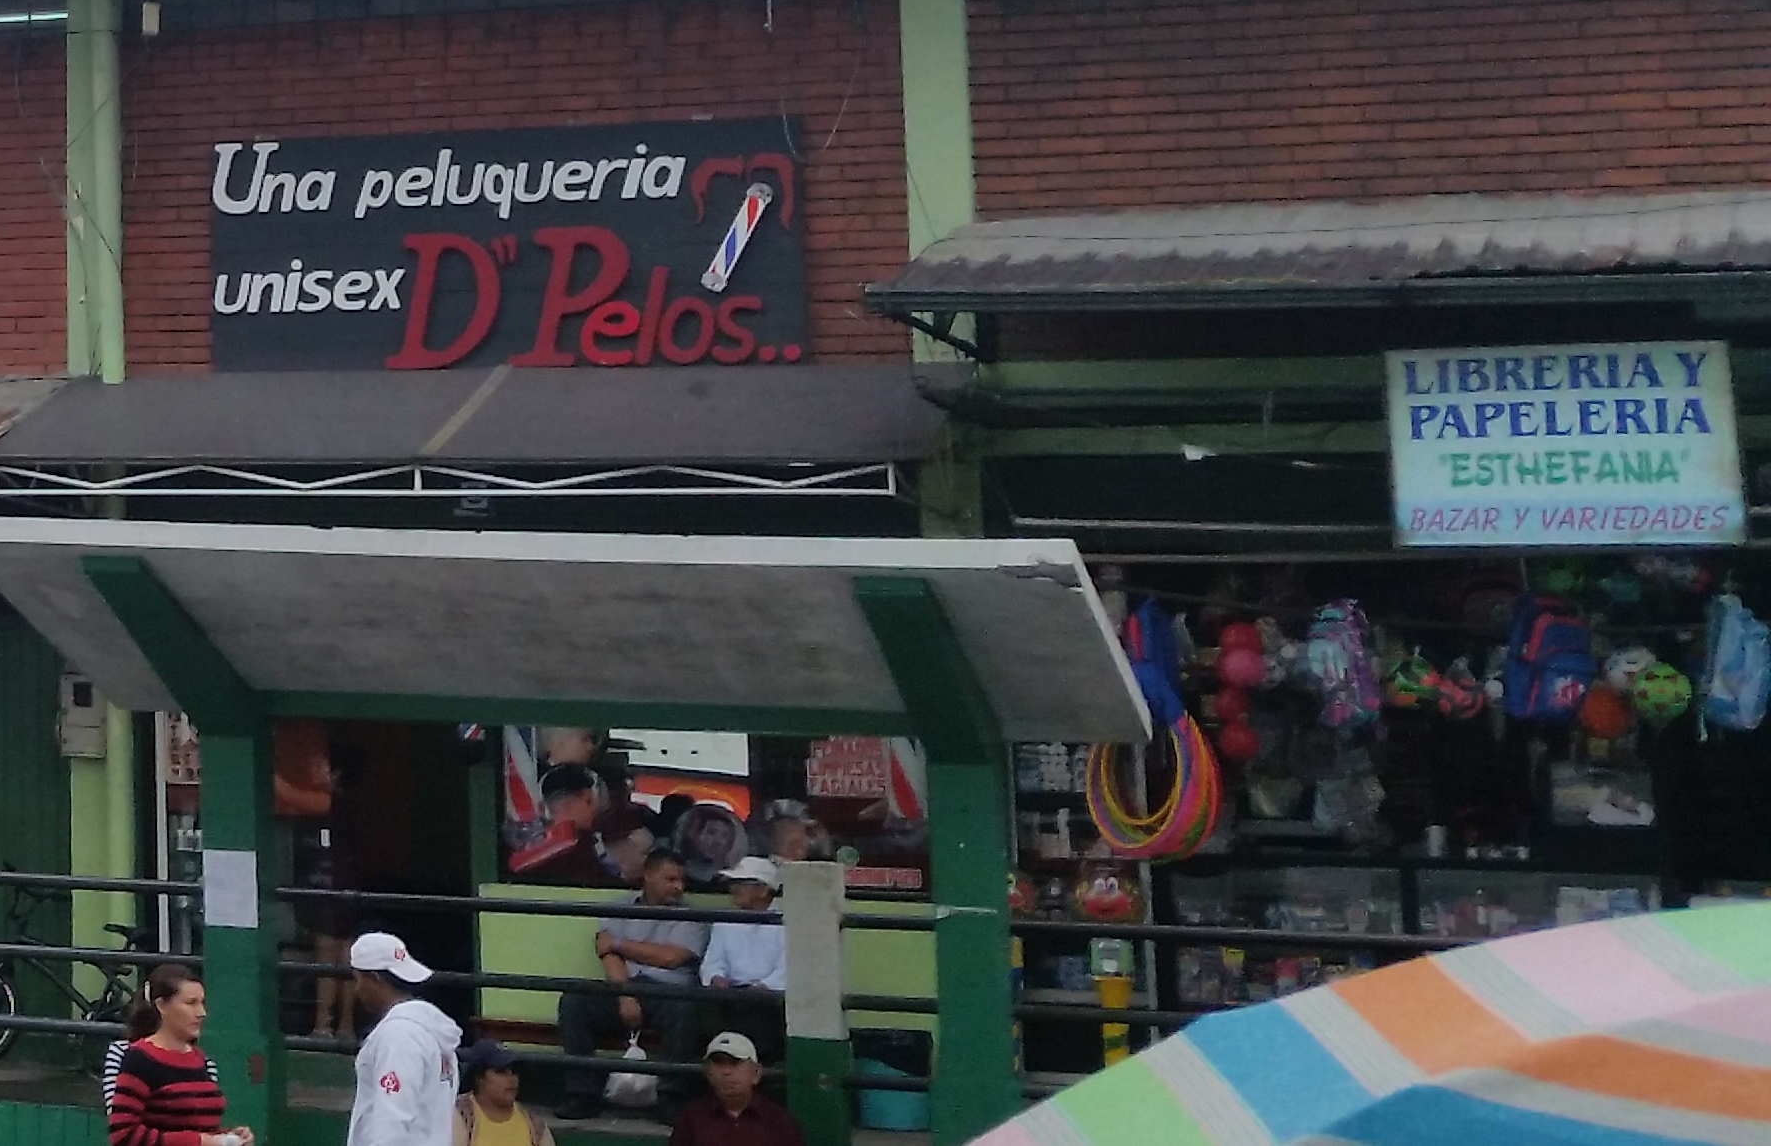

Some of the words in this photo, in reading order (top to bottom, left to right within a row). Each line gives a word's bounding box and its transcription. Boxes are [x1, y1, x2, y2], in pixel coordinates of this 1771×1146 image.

[212, 142, 335, 215] Una
[354, 144, 688, 219] peluqueria
[213, 259, 407, 314] unisex
[1402, 353, 1663, 395] LIBRERIA
[1674, 353, 1707, 388] Y
[1409, 397, 1712, 441] PAPELERIA
[1410, 506, 1501, 533] BAZAR
[1513, 507, 1529, 531] Y
[1541, 505, 1730, 532] VARIEDADES
